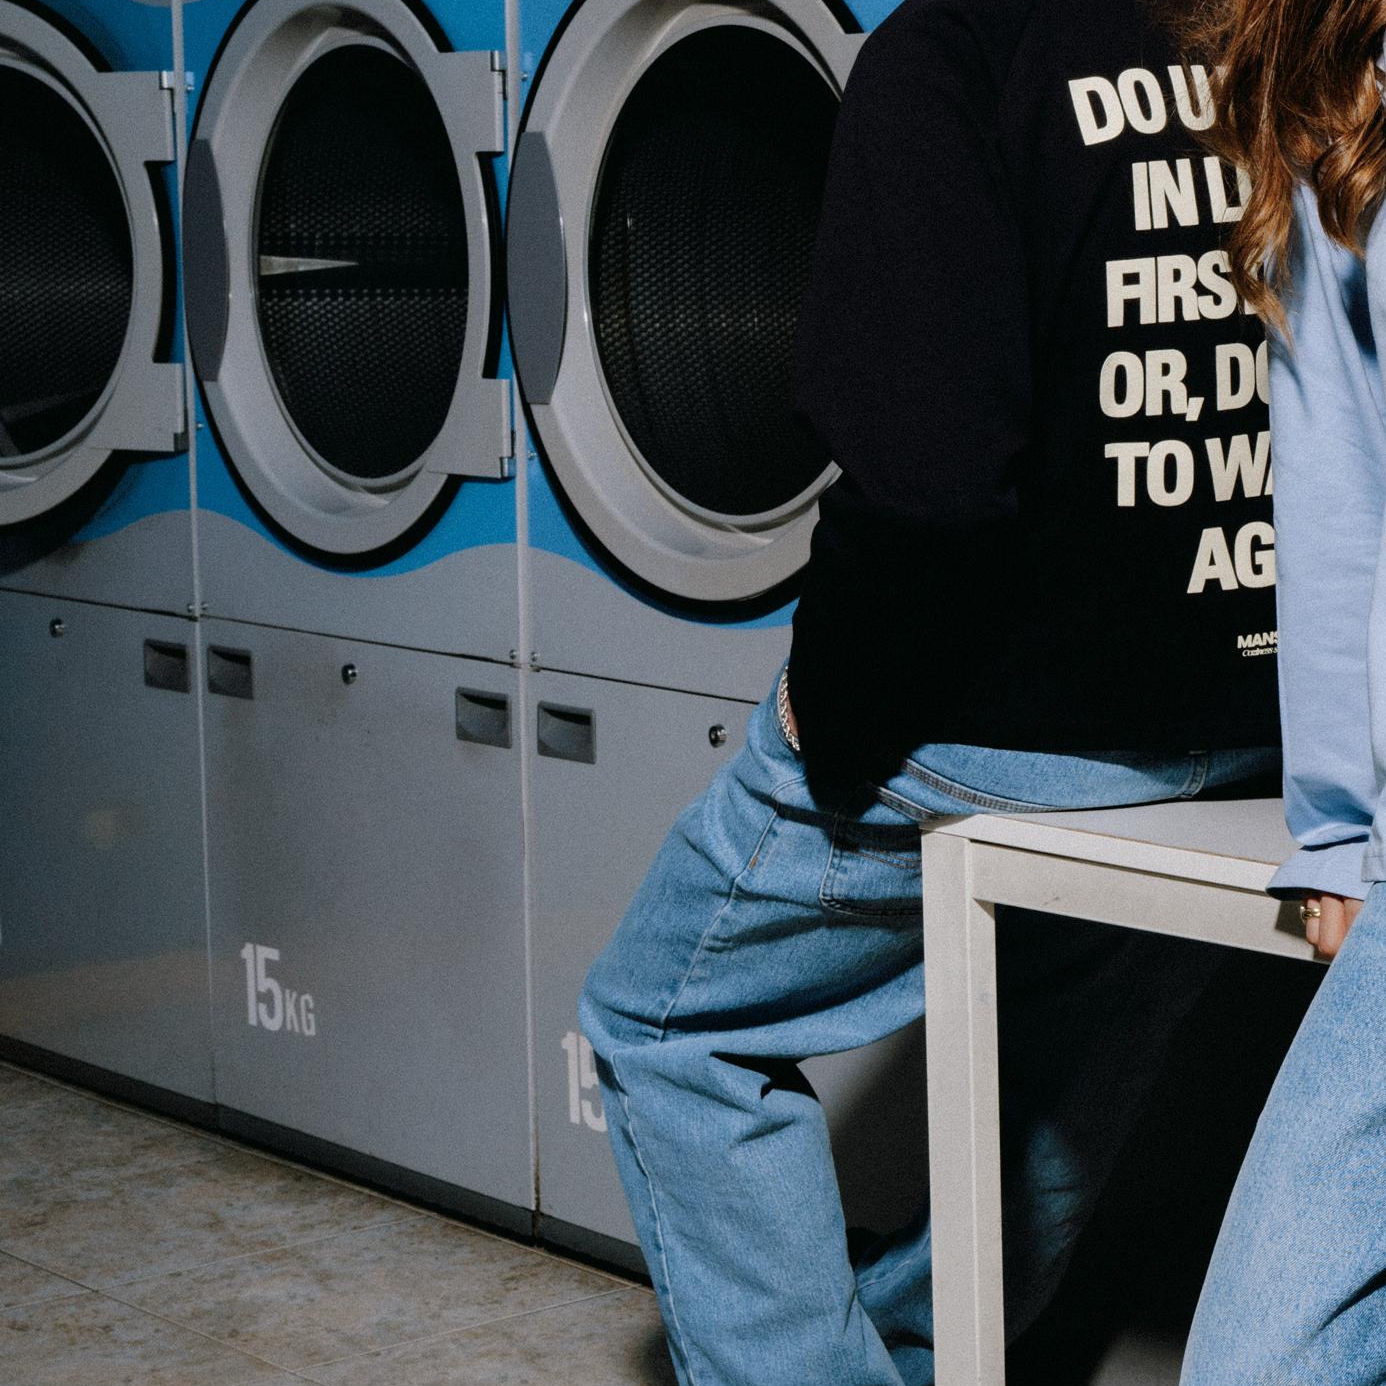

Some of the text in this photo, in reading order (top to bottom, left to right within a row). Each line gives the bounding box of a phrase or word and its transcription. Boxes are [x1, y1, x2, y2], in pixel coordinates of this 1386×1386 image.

[1068, 67, 1167, 146] DO
[1132, 156, 1253, 231] IN L
[1106, 250, 1259, 328] FIRS
[1099, 348, 1205, 422] OR,
[1104, 430, 1273, 507] TO W
